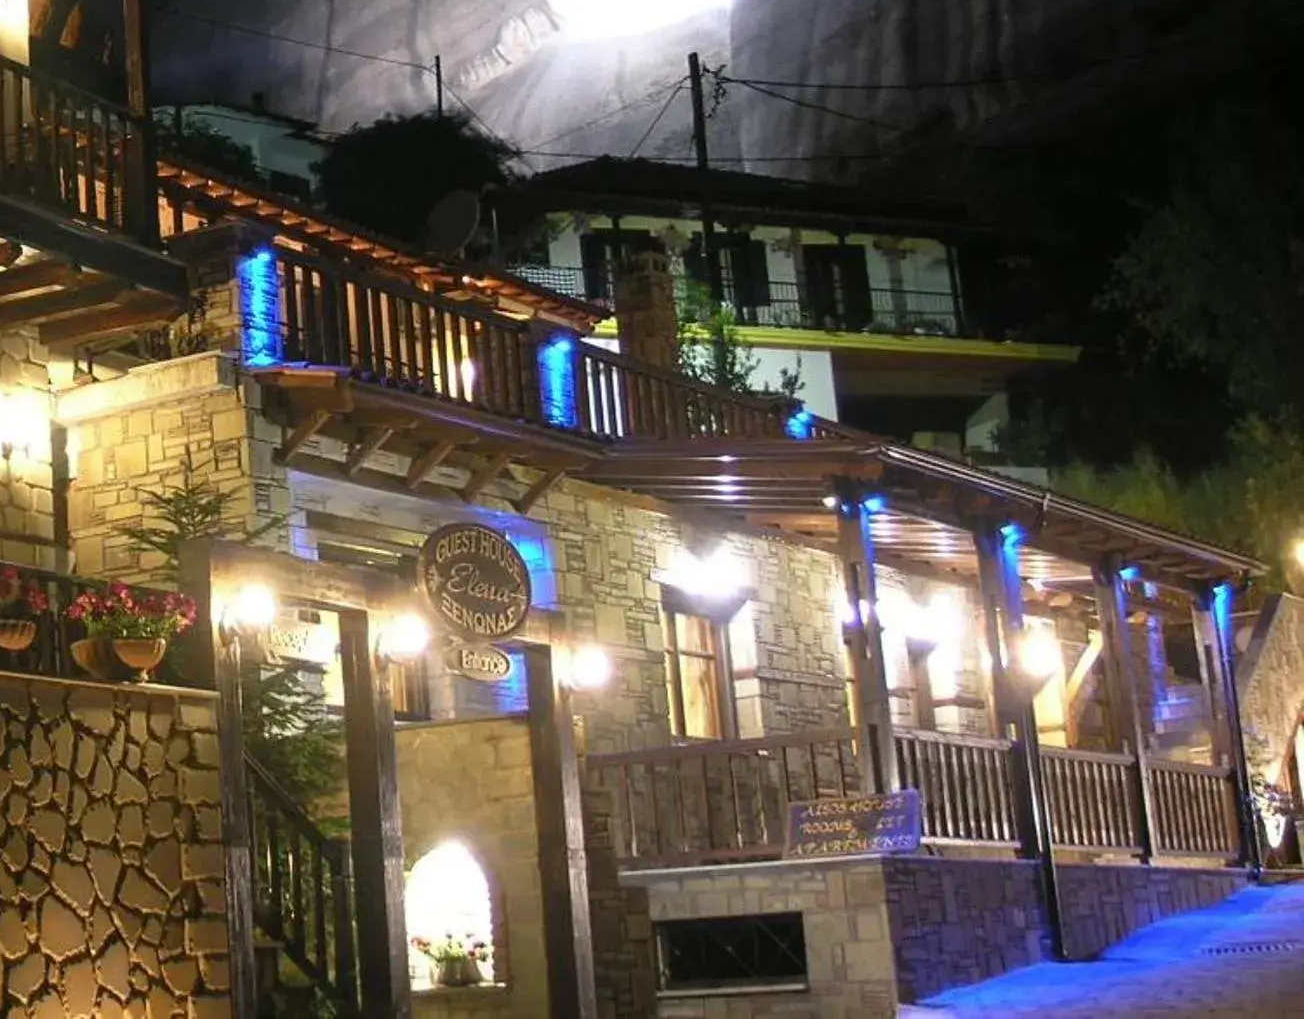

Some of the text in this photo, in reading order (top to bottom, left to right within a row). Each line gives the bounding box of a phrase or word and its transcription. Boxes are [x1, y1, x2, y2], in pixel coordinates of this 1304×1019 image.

[435, 531, 522, 583] GUEST HOUSE
[446, 562, 512, 603] Elena
